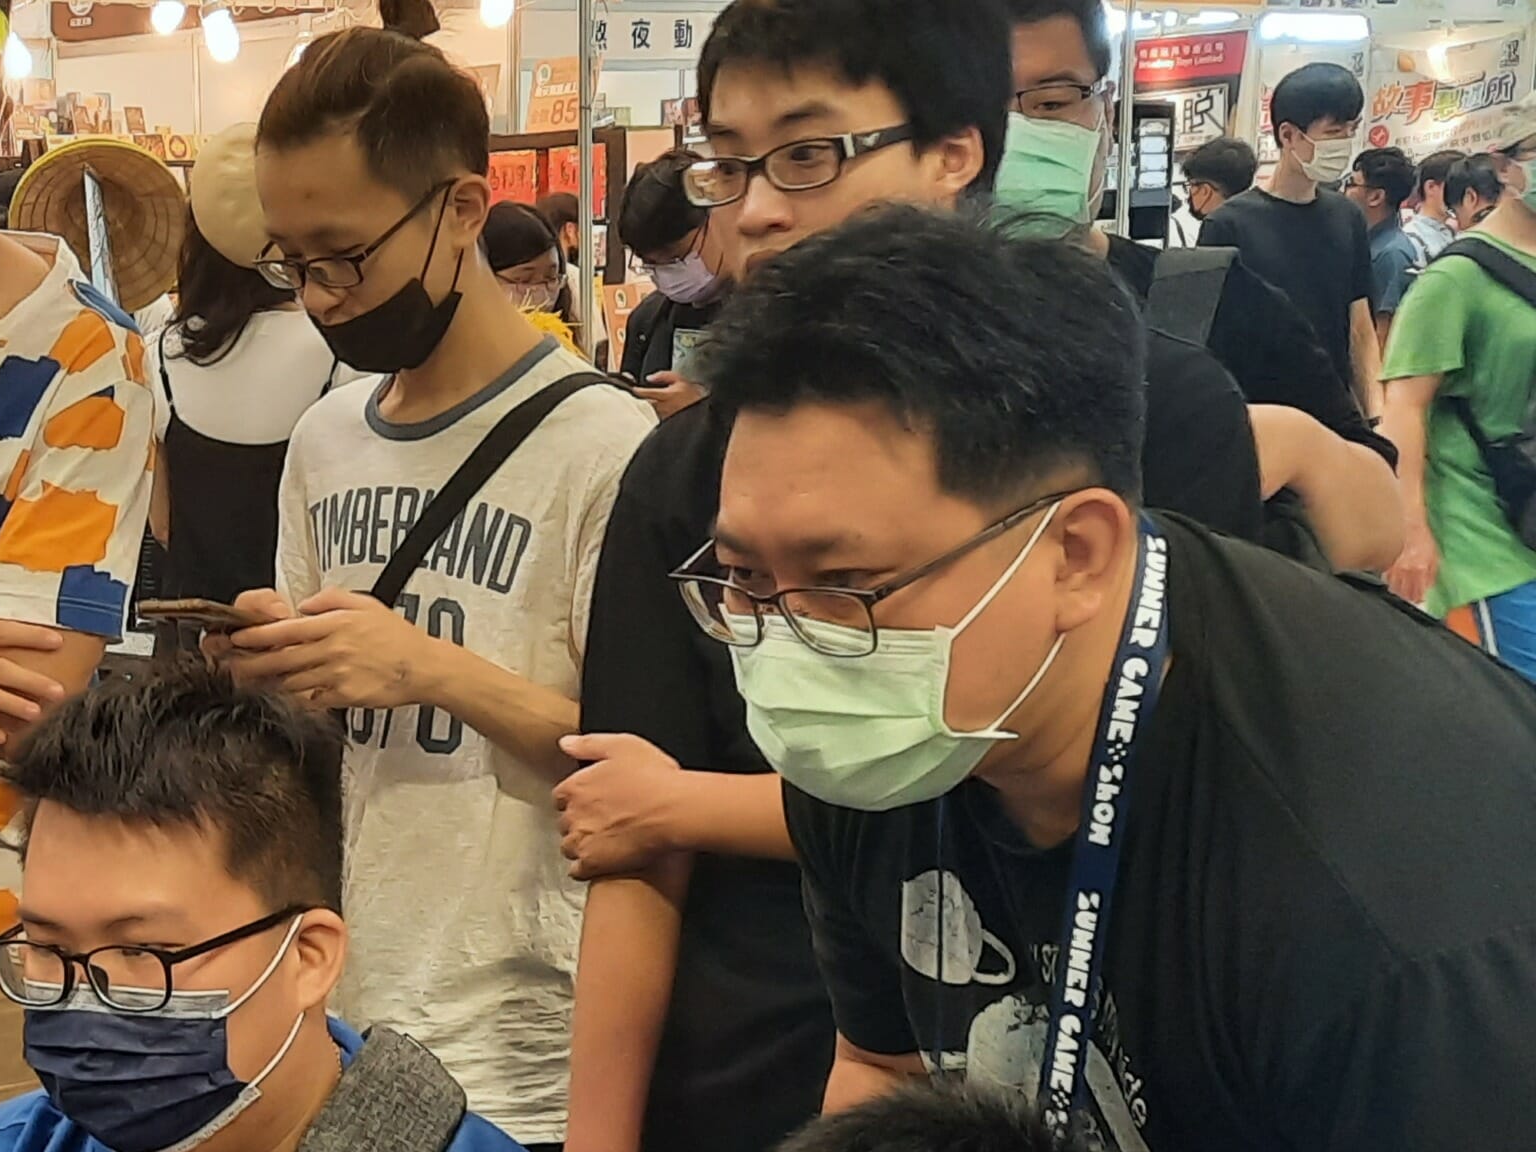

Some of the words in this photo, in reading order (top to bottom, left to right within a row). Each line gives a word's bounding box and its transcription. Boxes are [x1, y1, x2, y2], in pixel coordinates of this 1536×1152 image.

[309, 486, 532, 594] TIMBERAND
[1128, 534, 1167, 650] SUMMER
[1106, 656, 1150, 744] GAME
[1064, 891, 1100, 1009] SUMMER
[1050, 1014, 1082, 1094] GAME
